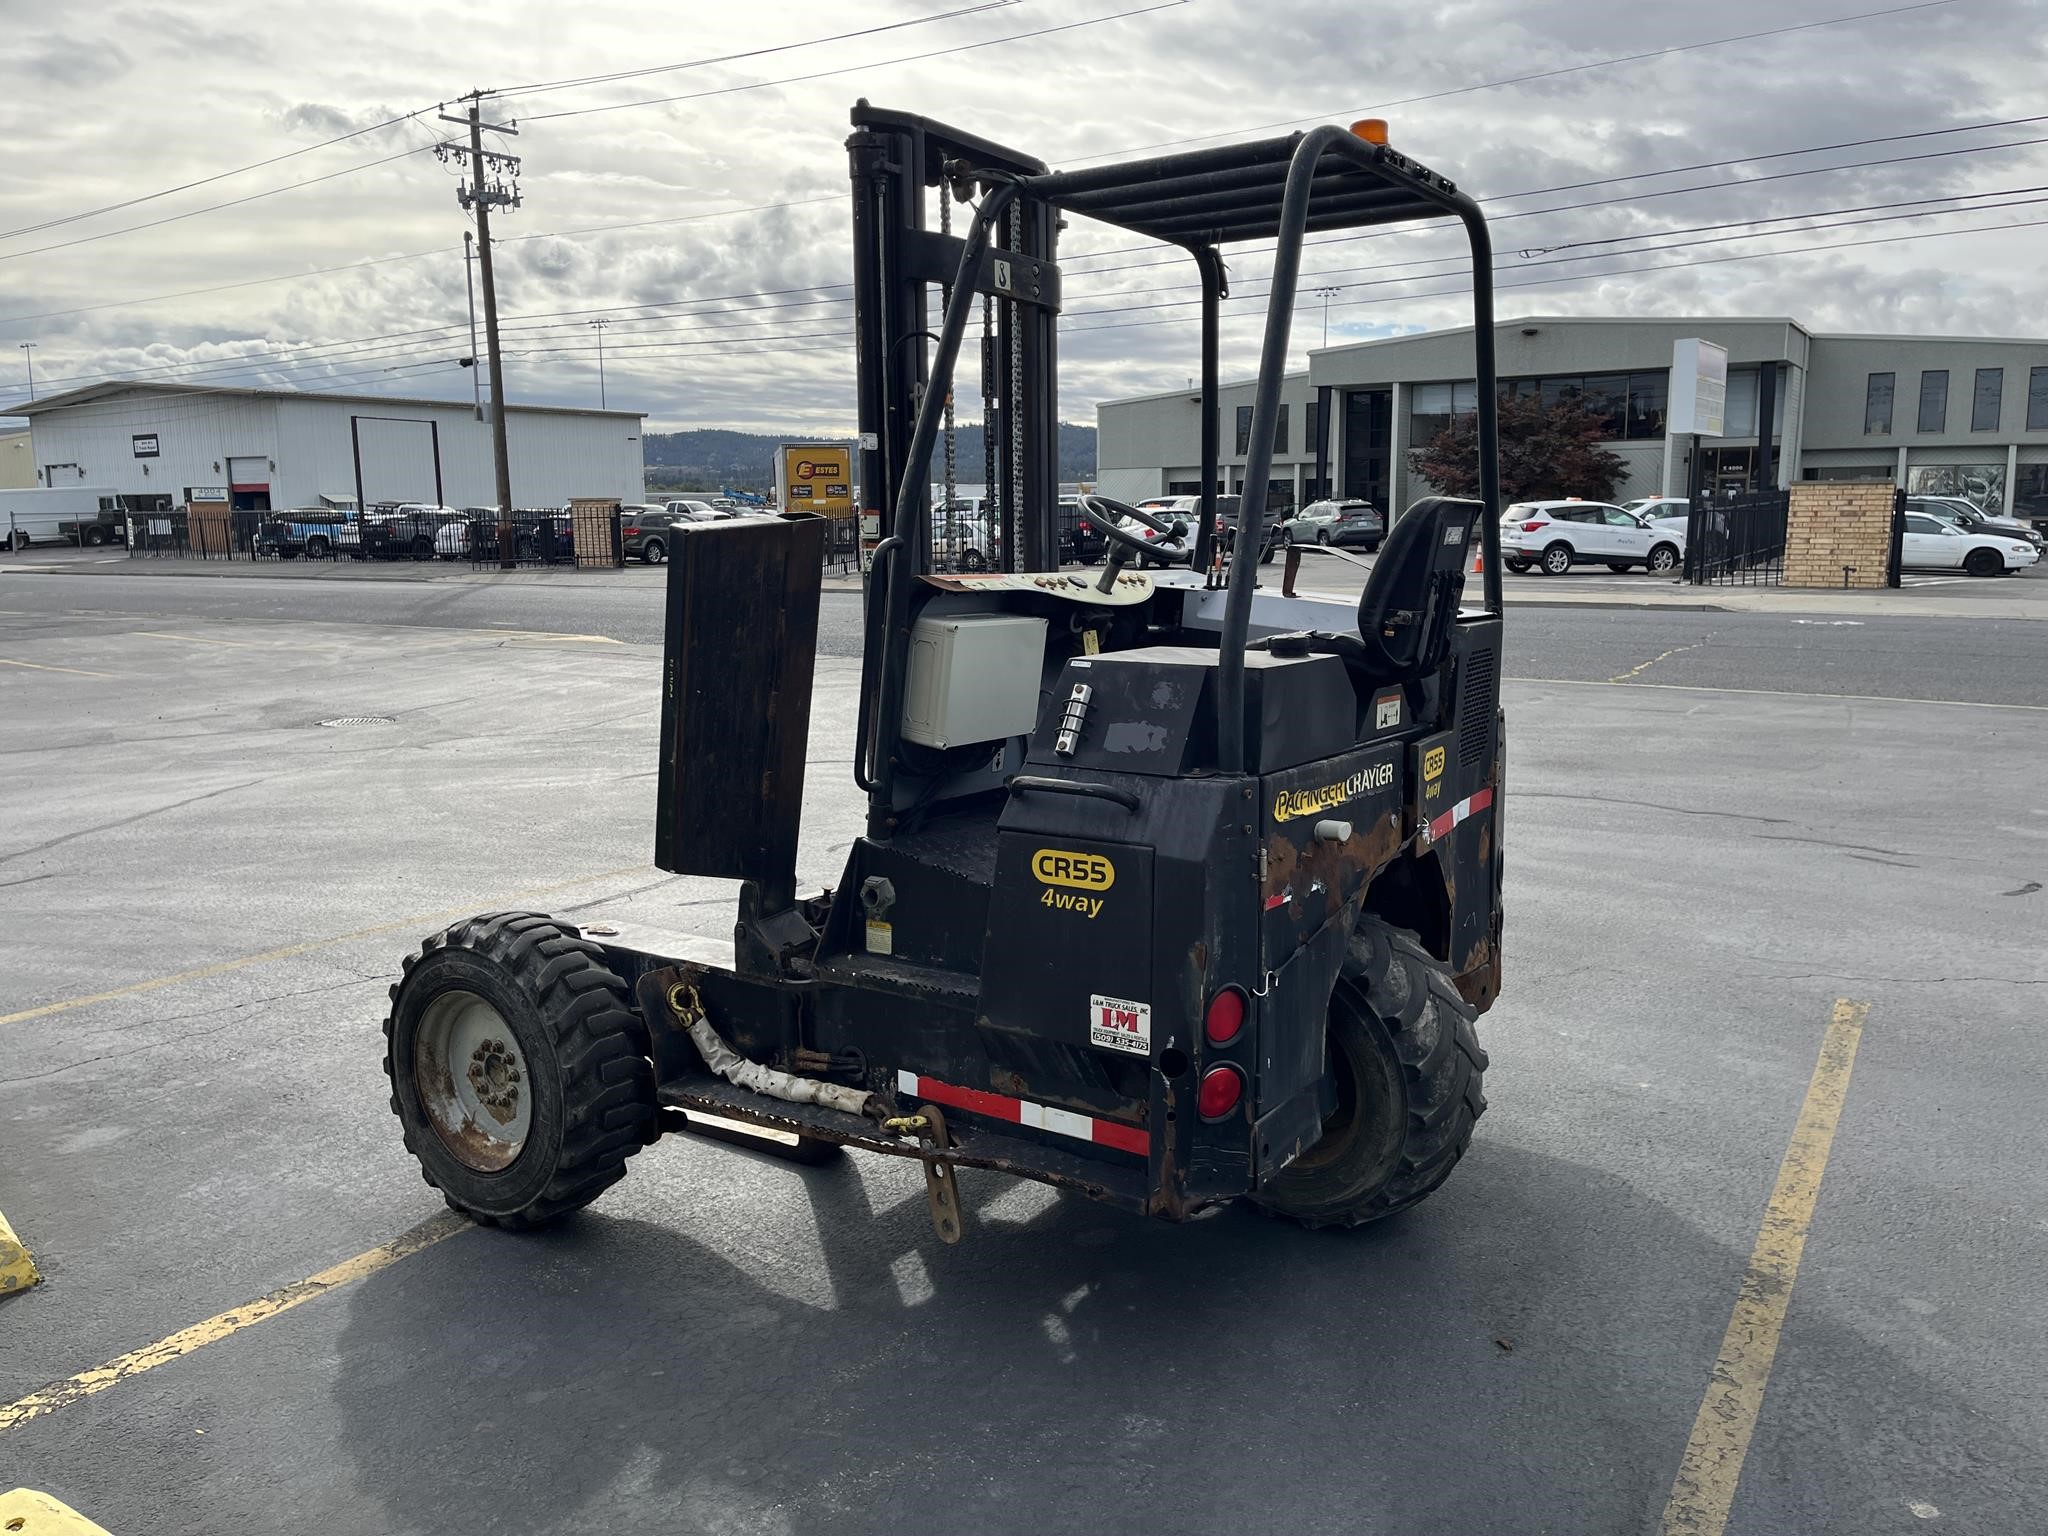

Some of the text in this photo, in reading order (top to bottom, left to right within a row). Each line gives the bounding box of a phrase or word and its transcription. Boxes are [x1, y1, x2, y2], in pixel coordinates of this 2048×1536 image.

[815, 466, 838, 474] ESTES
[1425, 751, 1443, 775] CR55
[1425, 781, 1441, 800] 4way
[1038, 855, 1107, 883] CR55
[1041, 888, 1104, 918] 4way
[1105, 1001, 1121, 1009] TRUCK
[1094, 1032, 1148, 1050] (509) 535-4175
